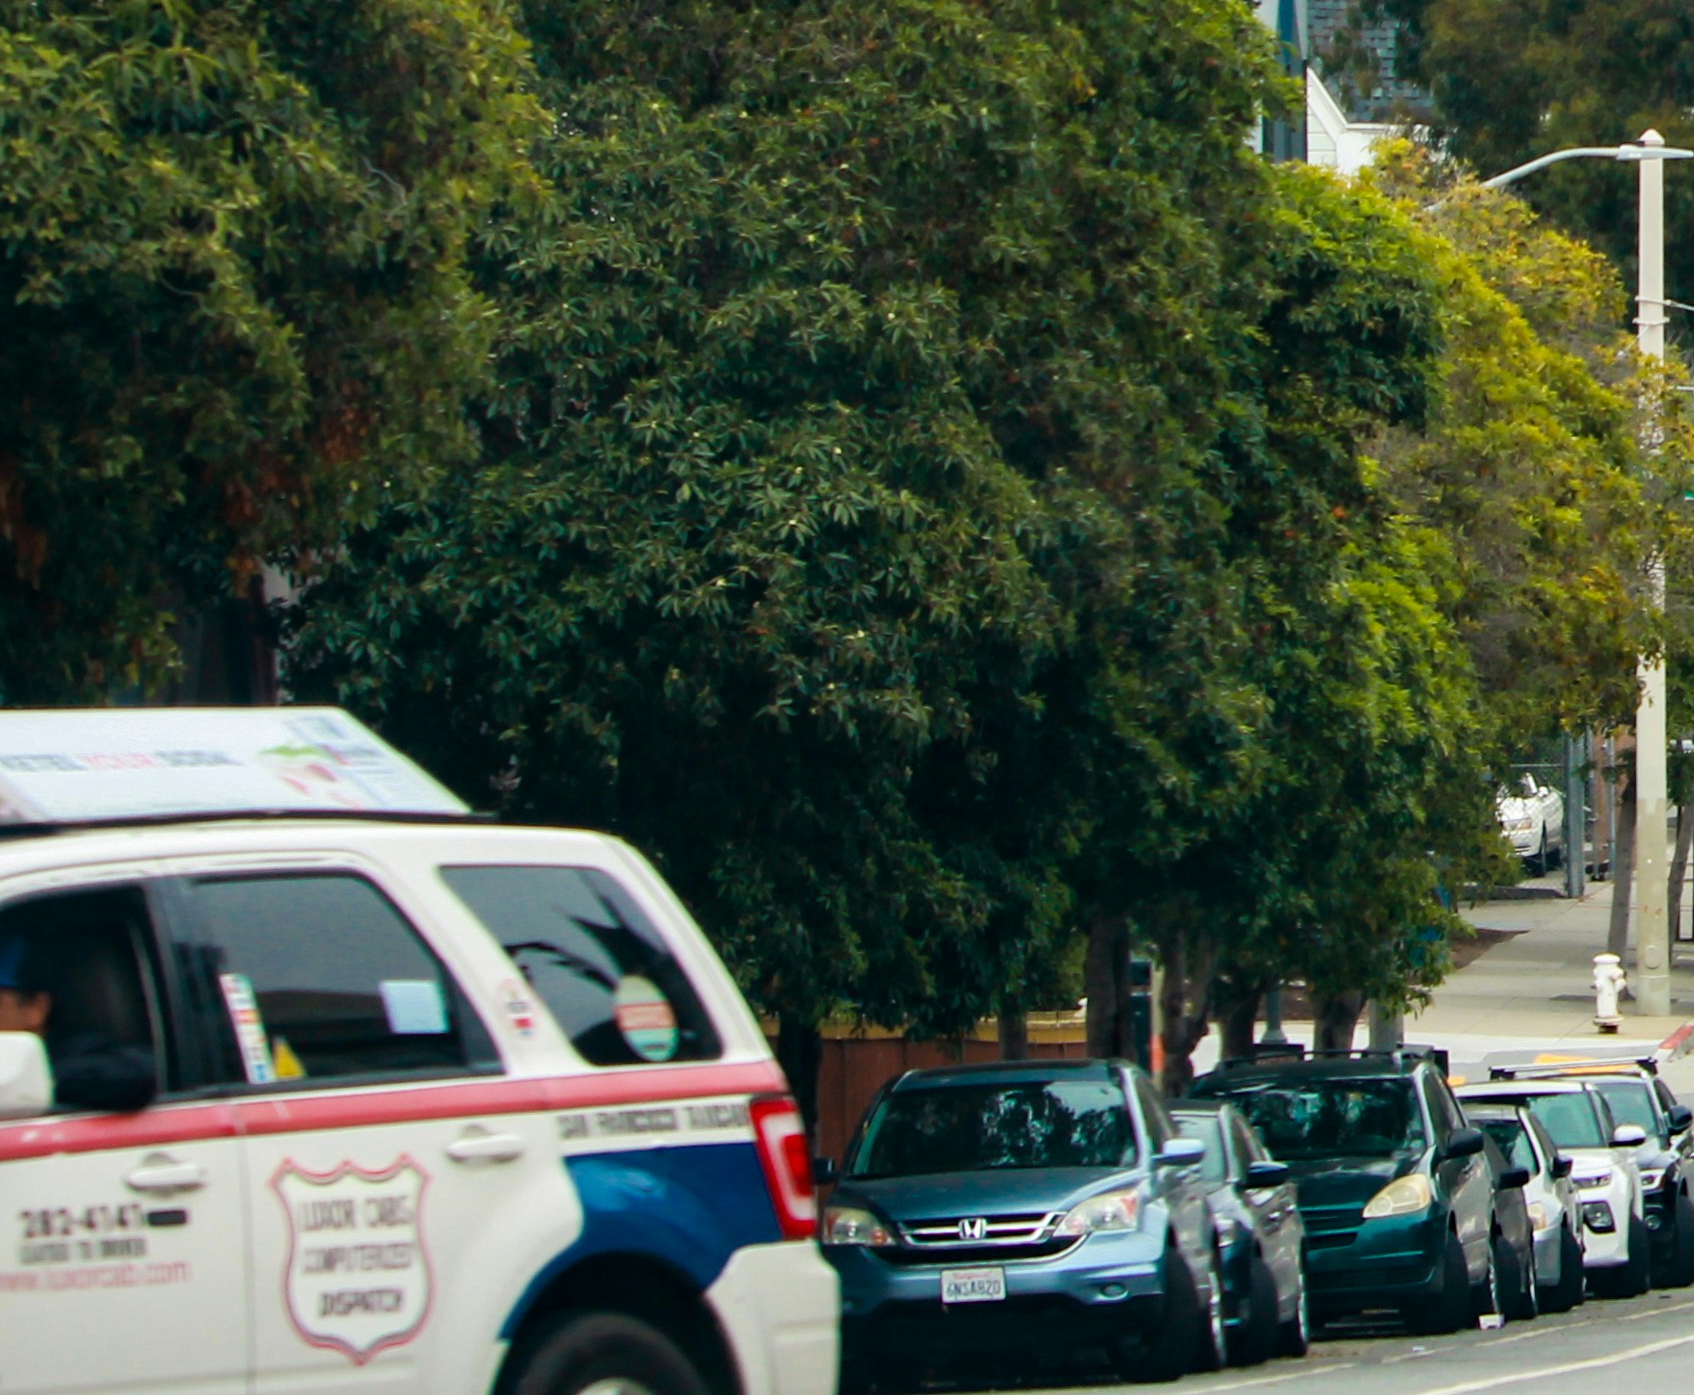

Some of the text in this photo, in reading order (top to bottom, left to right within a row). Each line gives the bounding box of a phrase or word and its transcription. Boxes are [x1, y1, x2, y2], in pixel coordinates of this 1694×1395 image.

[301, 1195, 413, 1231] LUXOR CABS
[302, 1242, 413, 1274] COMPUTERIZED
[320, 1287, 404, 1317] DISPATCH
